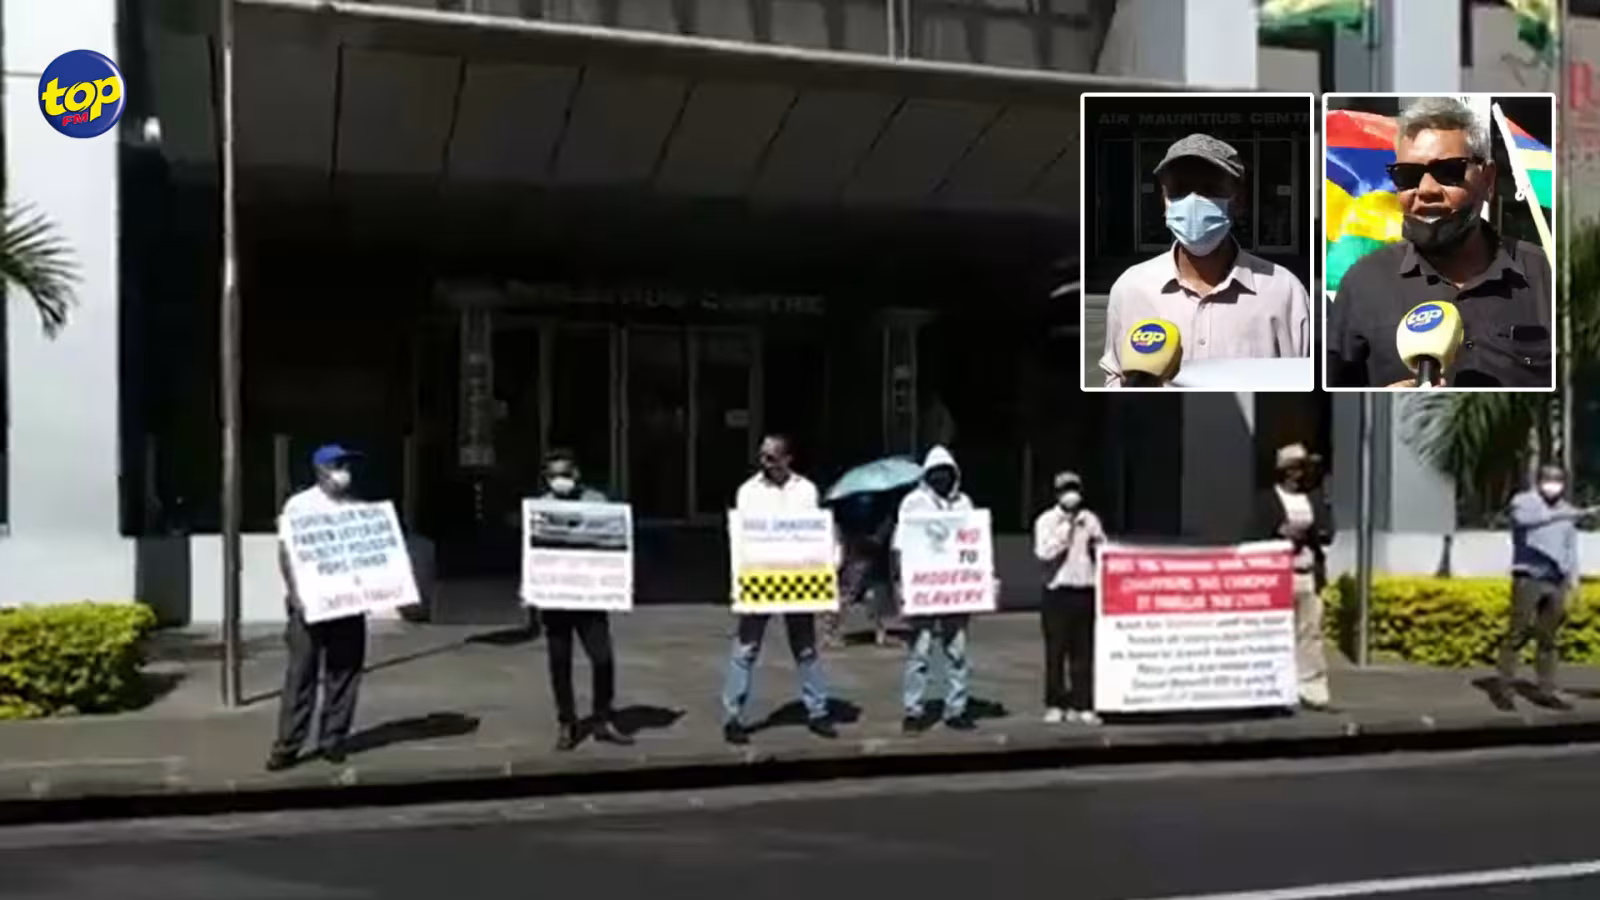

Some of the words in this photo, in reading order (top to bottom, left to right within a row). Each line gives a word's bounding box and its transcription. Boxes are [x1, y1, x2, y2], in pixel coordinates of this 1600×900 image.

[1098, 112, 1130, 125] AIR
[1138, 112, 1242, 125] MAURITIUS
[956, 527, 982, 545] NO
[959, 549, 979, 565] TO
[911, 568, 986, 587] MODERN
[911, 589, 986, 608] SLAVERY
